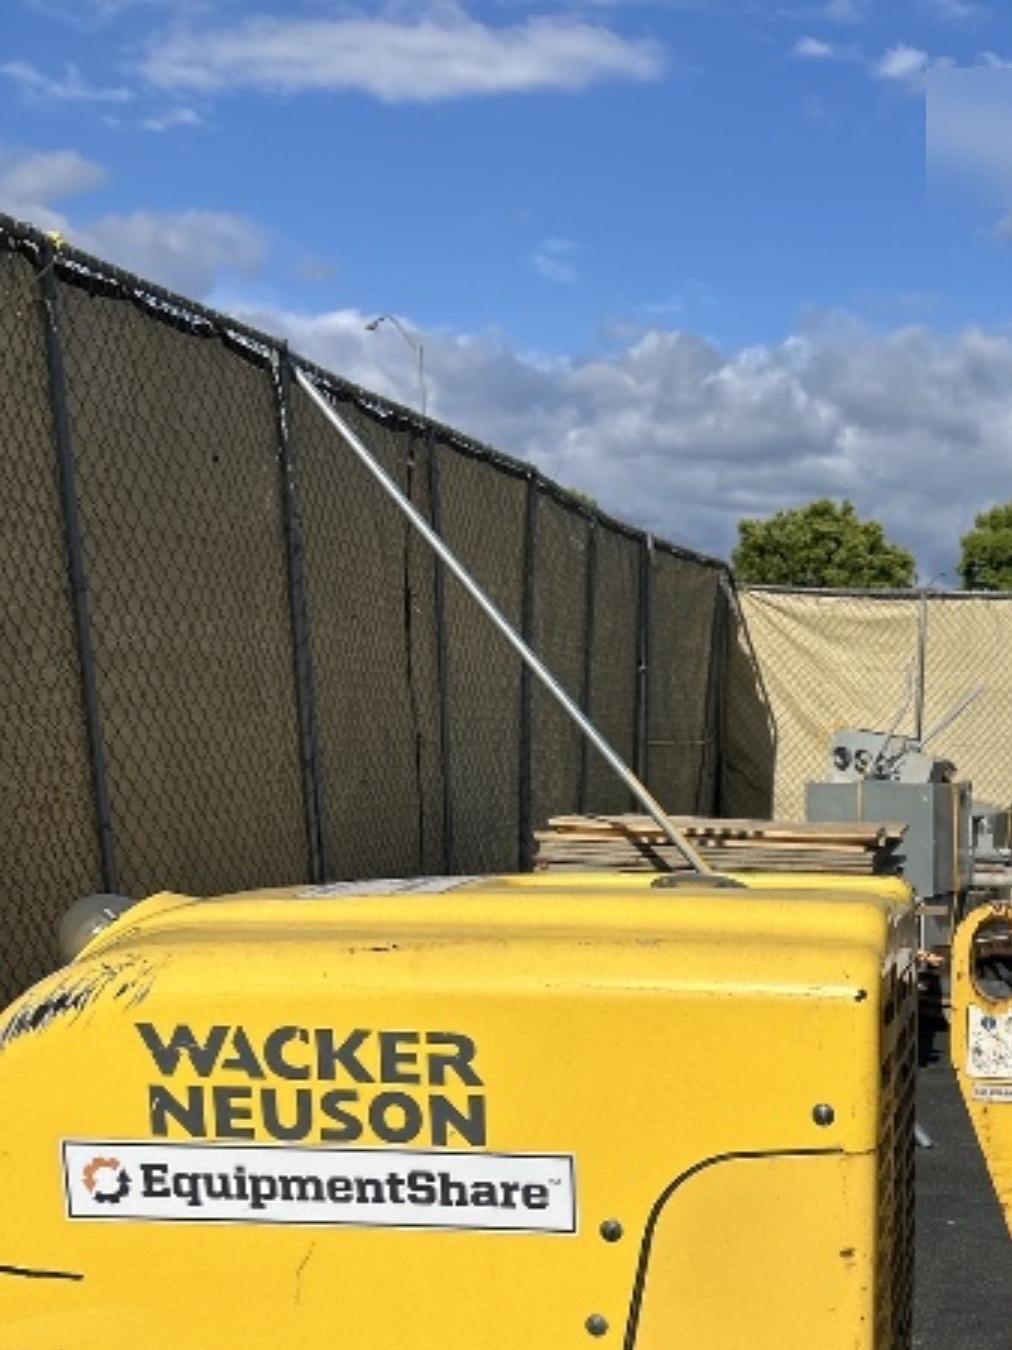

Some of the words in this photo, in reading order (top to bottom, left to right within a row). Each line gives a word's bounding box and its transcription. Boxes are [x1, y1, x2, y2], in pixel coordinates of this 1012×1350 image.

[135, 1022, 485, 1086] WACKER
[148, 1083, 486, 1146] NEUSON
[140, 1162, 550, 1210] EquipmentShare
